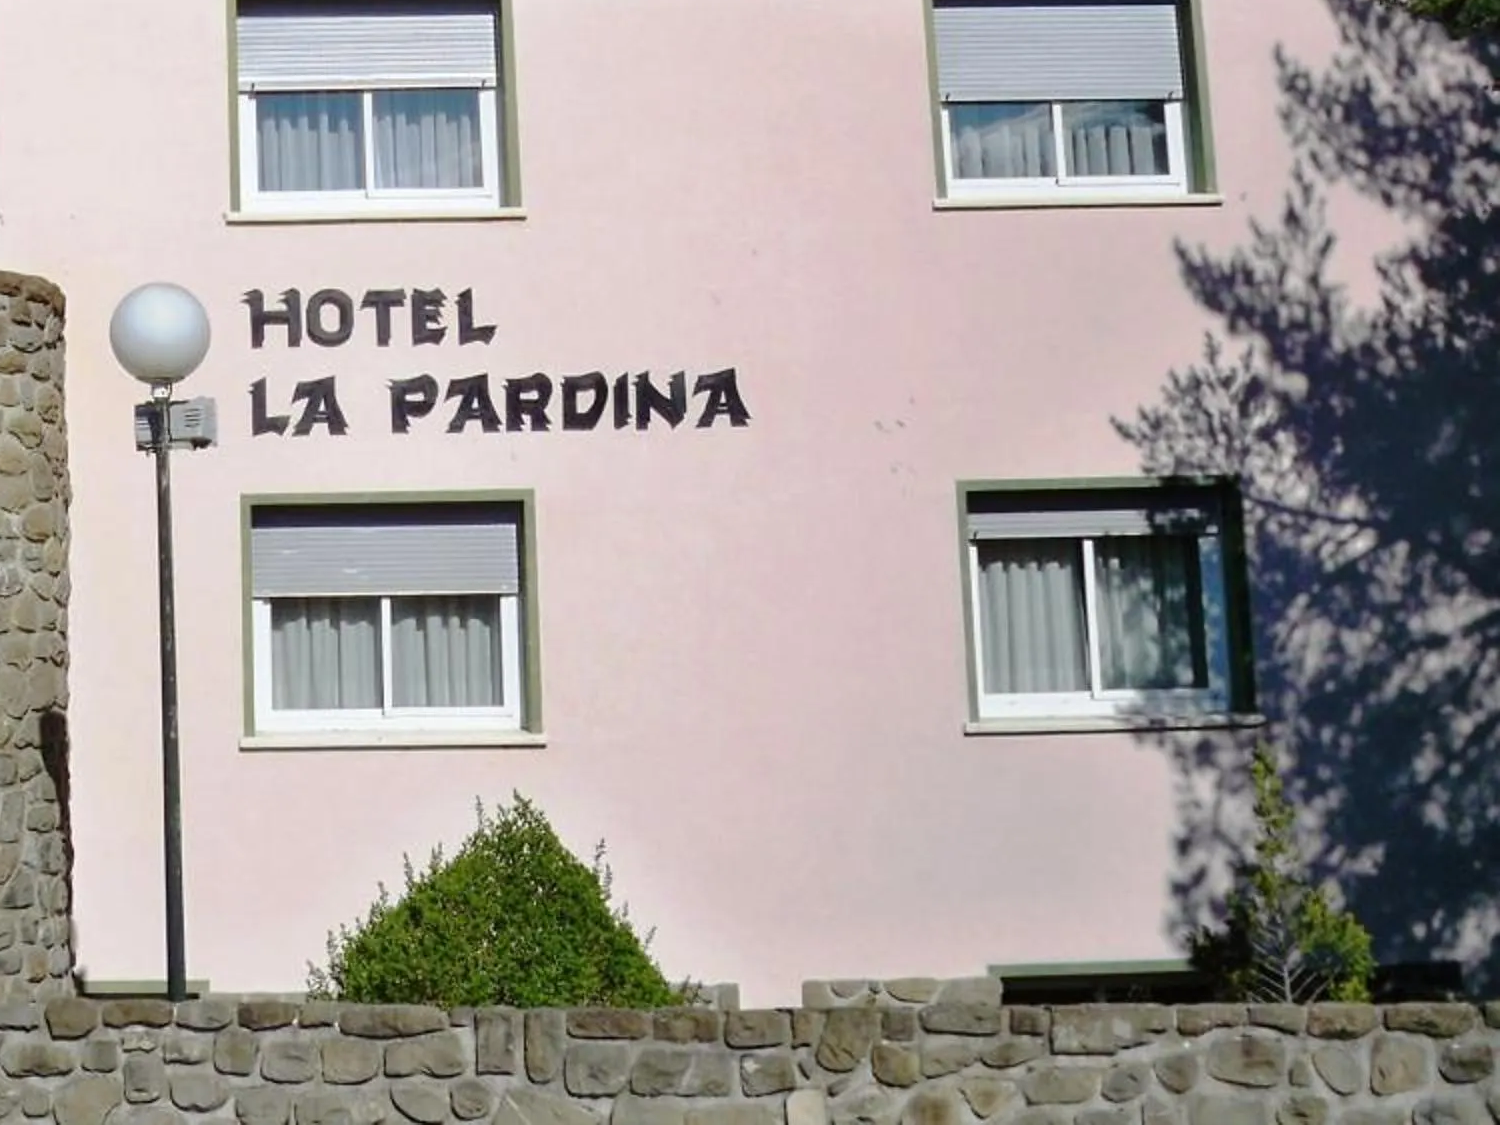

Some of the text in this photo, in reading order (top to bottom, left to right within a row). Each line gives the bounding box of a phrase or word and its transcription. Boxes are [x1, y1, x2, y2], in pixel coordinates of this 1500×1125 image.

[242, 287, 498, 349] HOTEL
[250, 368, 752, 436] LA PARDINA
